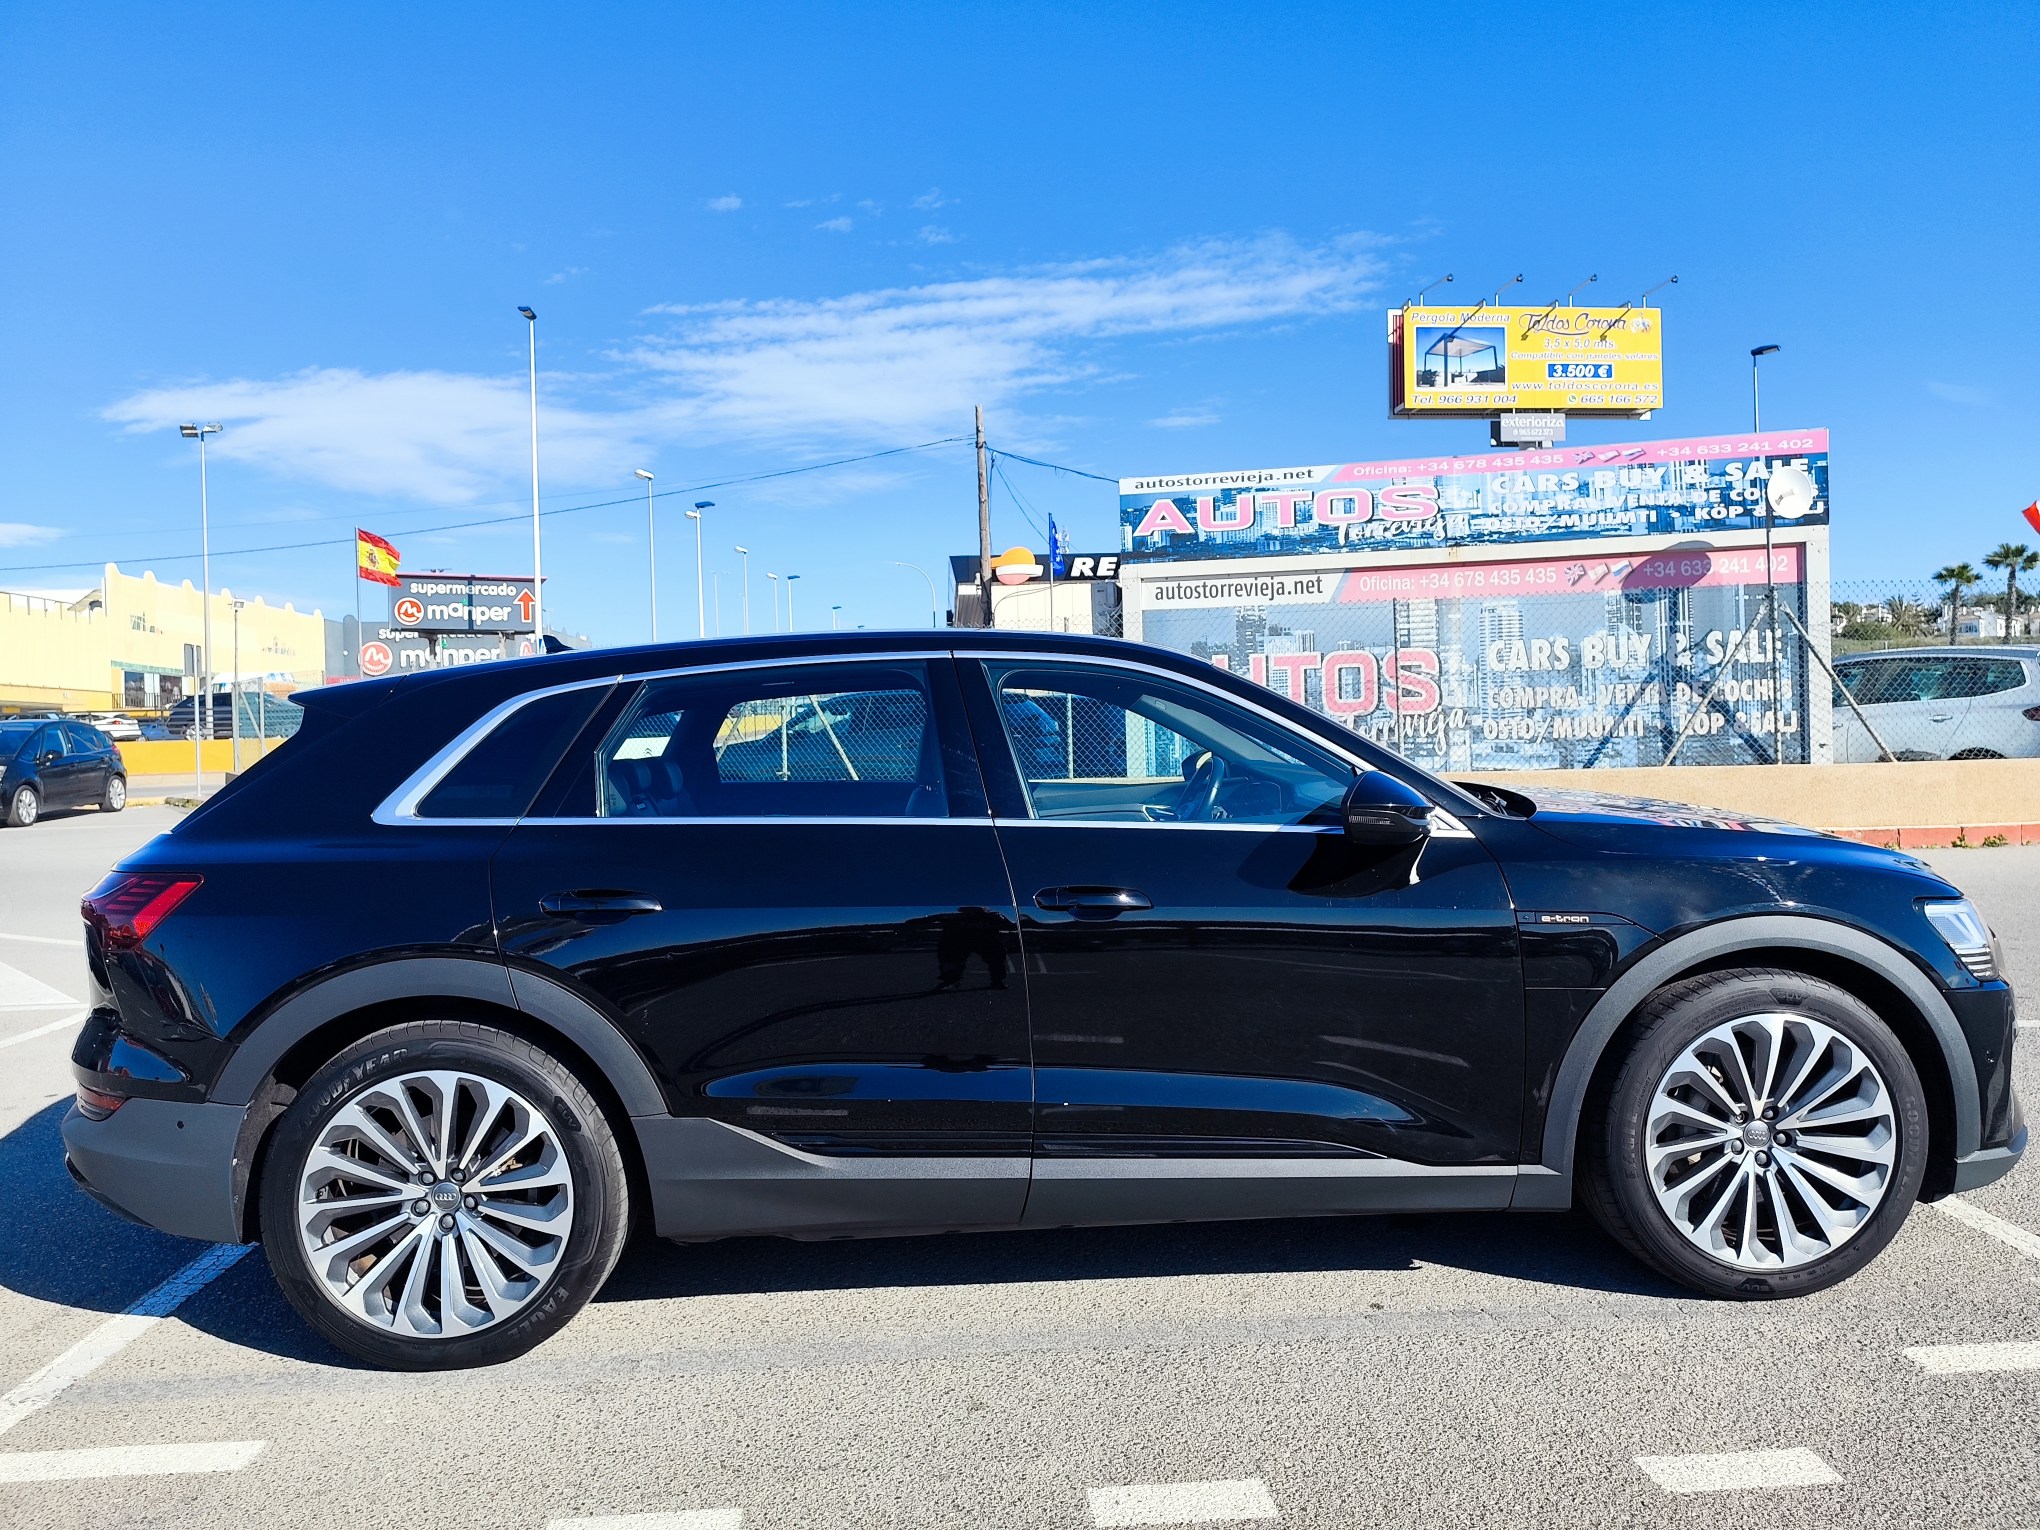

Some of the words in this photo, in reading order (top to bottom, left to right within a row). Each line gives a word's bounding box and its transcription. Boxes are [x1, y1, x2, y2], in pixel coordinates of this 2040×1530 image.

[1460, 312, 1510, 322] Moderna
[1564, 340, 1570, 348] x
[1511, 351, 1565, 360] Compatible
[1552, 364, 1595, 377] 3.500
[1597, 365, 1609, 377] €
[1412, 395, 1433, 404] Tel.
[1438, 395, 1462, 404] 966
[1466, 395, 1489, 404] 931
[1493, 394, 1518, 404] 004
[1580, 395, 1605, 404] 665
[1609, 395, 1632, 404] 166
[1634, 395, 1659, 404] 572
[1657, 446, 1692, 457] +34
[1696, 443, 1732, 455] 633
[1738, 441, 1773, 452] 241
[1778, 438, 1814, 449] 402
[1353, 465, 1412, 477] Oficina:
[1417, 461, 1449, 472] +34
[1454, 458, 1487, 470] 678
[1492, 456, 1525, 467] 435
[1530, 454, 1564, 465] 435
[1134, 468, 1315, 490] autostorrevieja.net
[1491, 472, 1580, 494] CARS
[1593, 467, 1668, 488] BUY
[1683, 464, 1709, 484] &
[1692, 489, 1722, 503] DE
[1132, 486, 1440, 537] AUTOS
[1694, 501, 1744, 520] KÖP
[1643, 560, 1676, 578] +34
[1680, 559, 1715, 576] 633
[1719, 556, 1751, 574] 241
[1154, 575, 1324, 602] autostorrevieja.net
[1359, 575, 1416, 592] Oficina:
[1419, 572, 1450, 589] +34
[1453, 571, 1485, 587] 678
[1489, 569, 1521, 586] 435
[1525, 567, 1557, 584] 435
[426, 602, 512, 626] manper
[1488, 636, 1572, 672] CARS
[1583, 633, 1652, 669] BUY
[1488, 684, 1580, 710] COMPRA
[1540, 914, 1590, 924] e-tron
